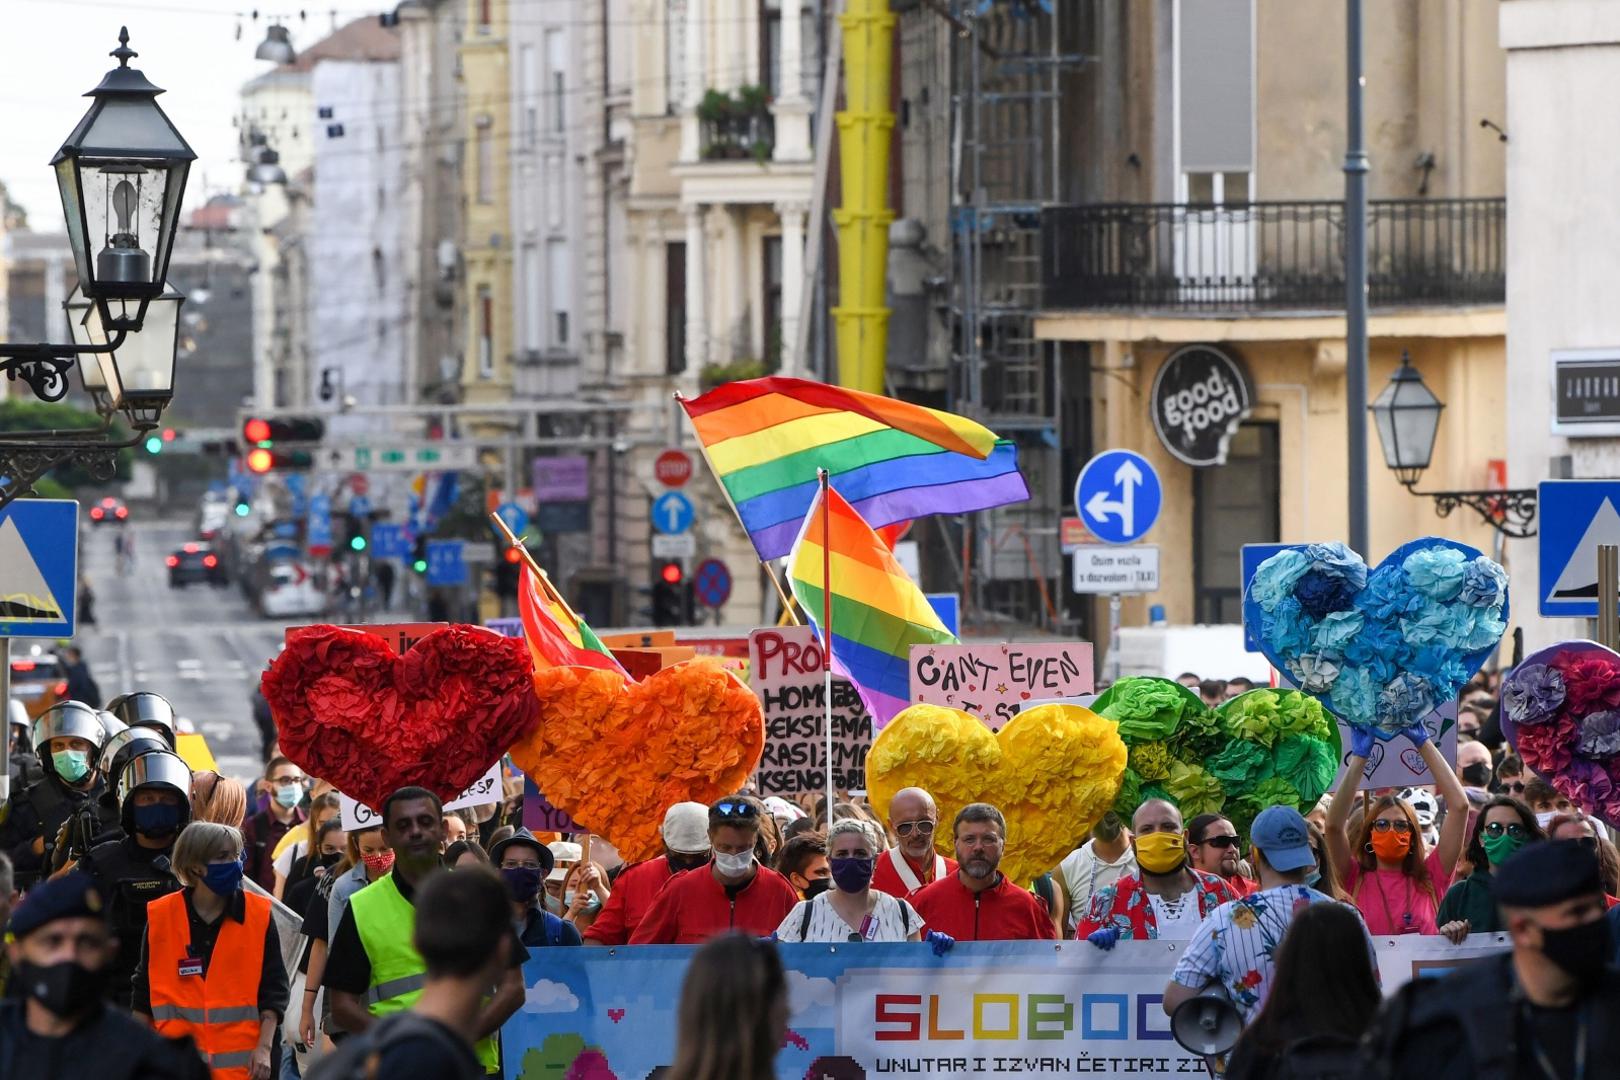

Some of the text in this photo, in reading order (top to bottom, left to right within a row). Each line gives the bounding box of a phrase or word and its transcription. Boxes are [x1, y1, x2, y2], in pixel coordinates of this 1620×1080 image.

[1164, 366, 1226, 427] good
[1183, 384, 1240, 442] food
[1009, 650, 1079, 690] EVEN
[876, 1058, 967, 1073] UNUTAR
[973, 1058, 986, 1072] I
[993, 1058, 1071, 1073] IZVAN
[1077, 1051, 1169, 1073] ČETIRI
